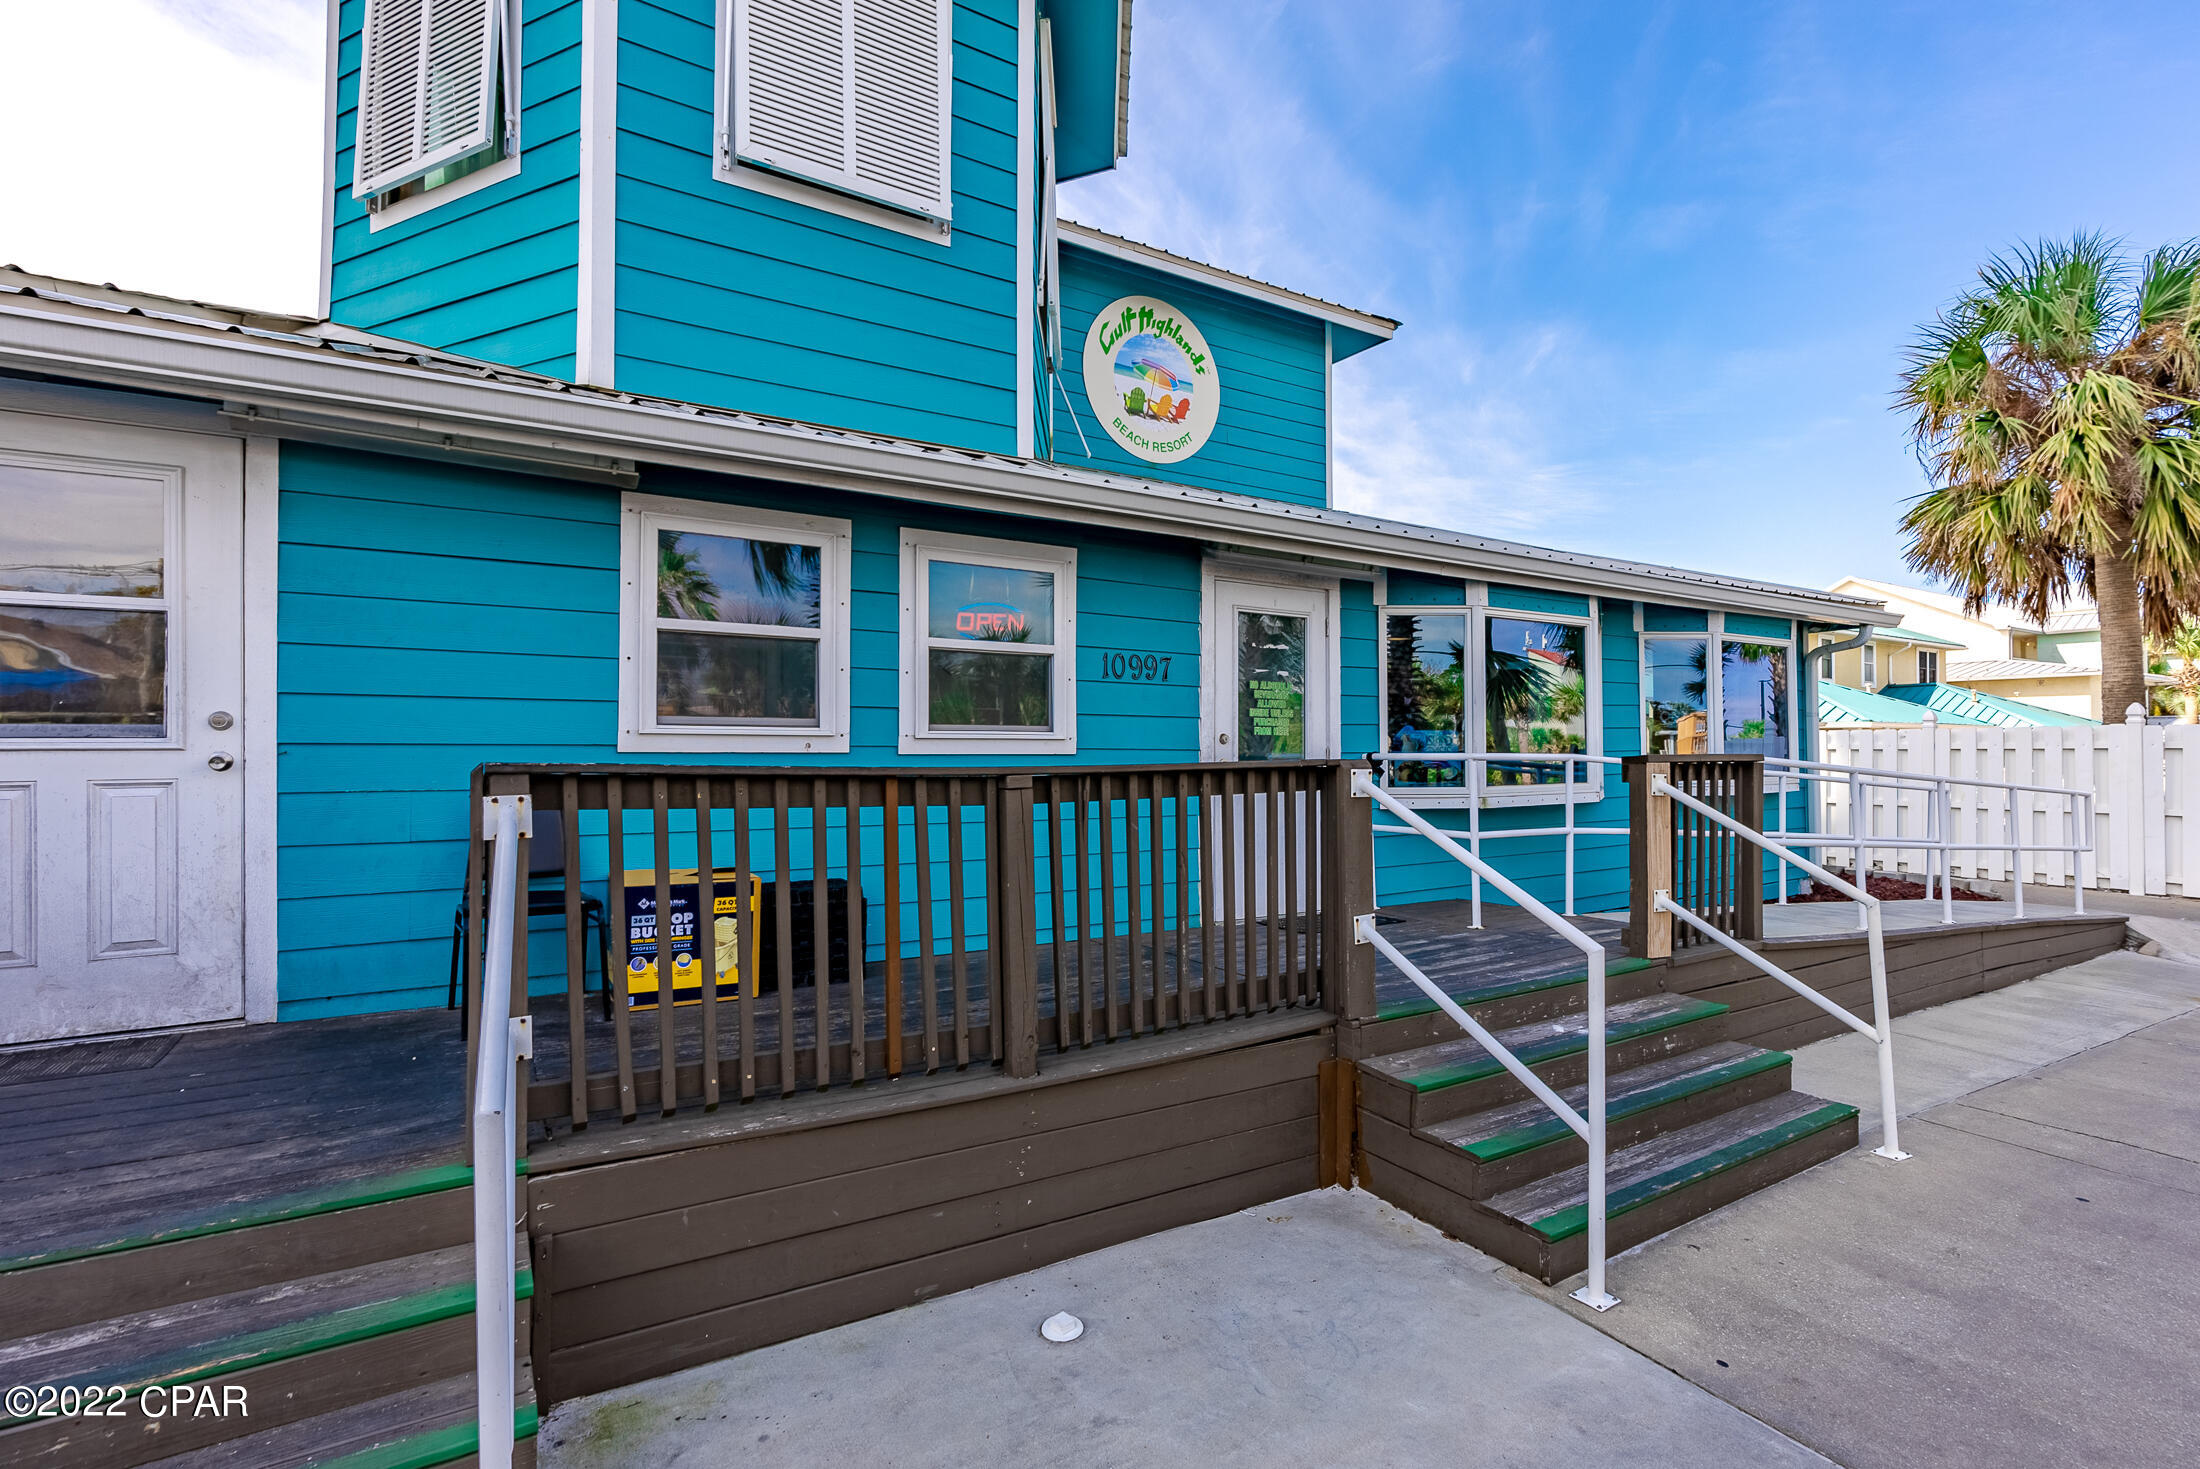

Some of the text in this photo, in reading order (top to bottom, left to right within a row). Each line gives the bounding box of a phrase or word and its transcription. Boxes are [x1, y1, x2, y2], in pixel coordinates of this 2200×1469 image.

[1099, 305, 1206, 375] Gulf Highlands
[1112, 417, 1193, 453] BEACH RESORT
[956, 612, 1024, 632] OPEN
[1102, 652, 1172, 682] 10997
